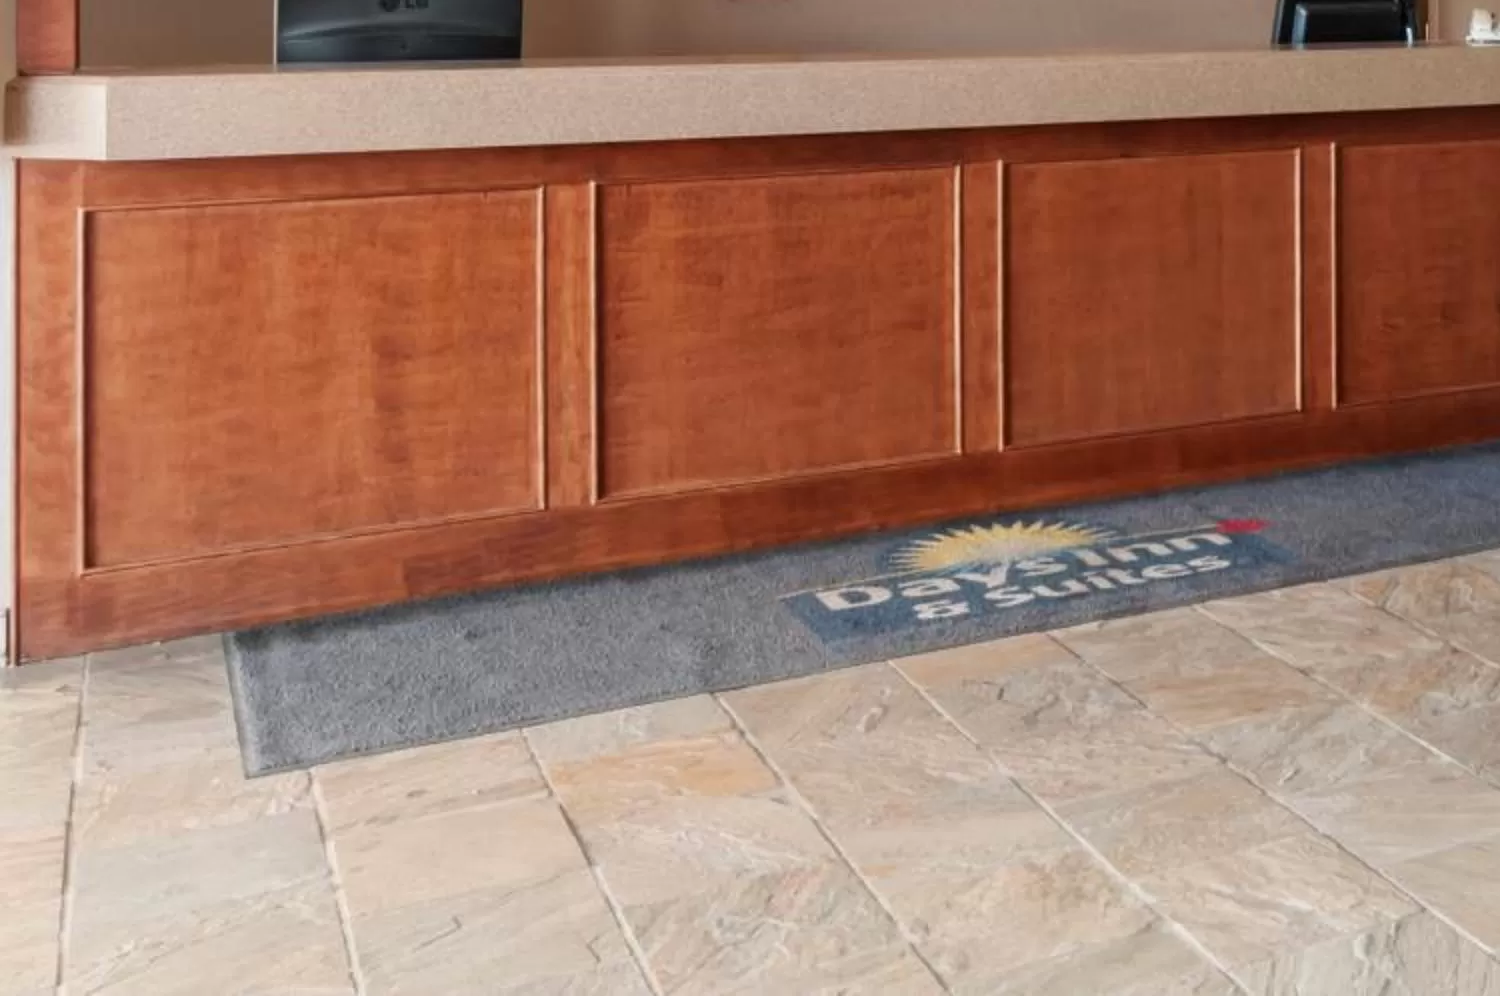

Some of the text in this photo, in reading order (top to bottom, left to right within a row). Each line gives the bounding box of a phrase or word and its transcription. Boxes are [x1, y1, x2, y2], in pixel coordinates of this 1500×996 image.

[815, 532, 1233, 611] Days Inn
[983, 555, 1231, 608] Suites
